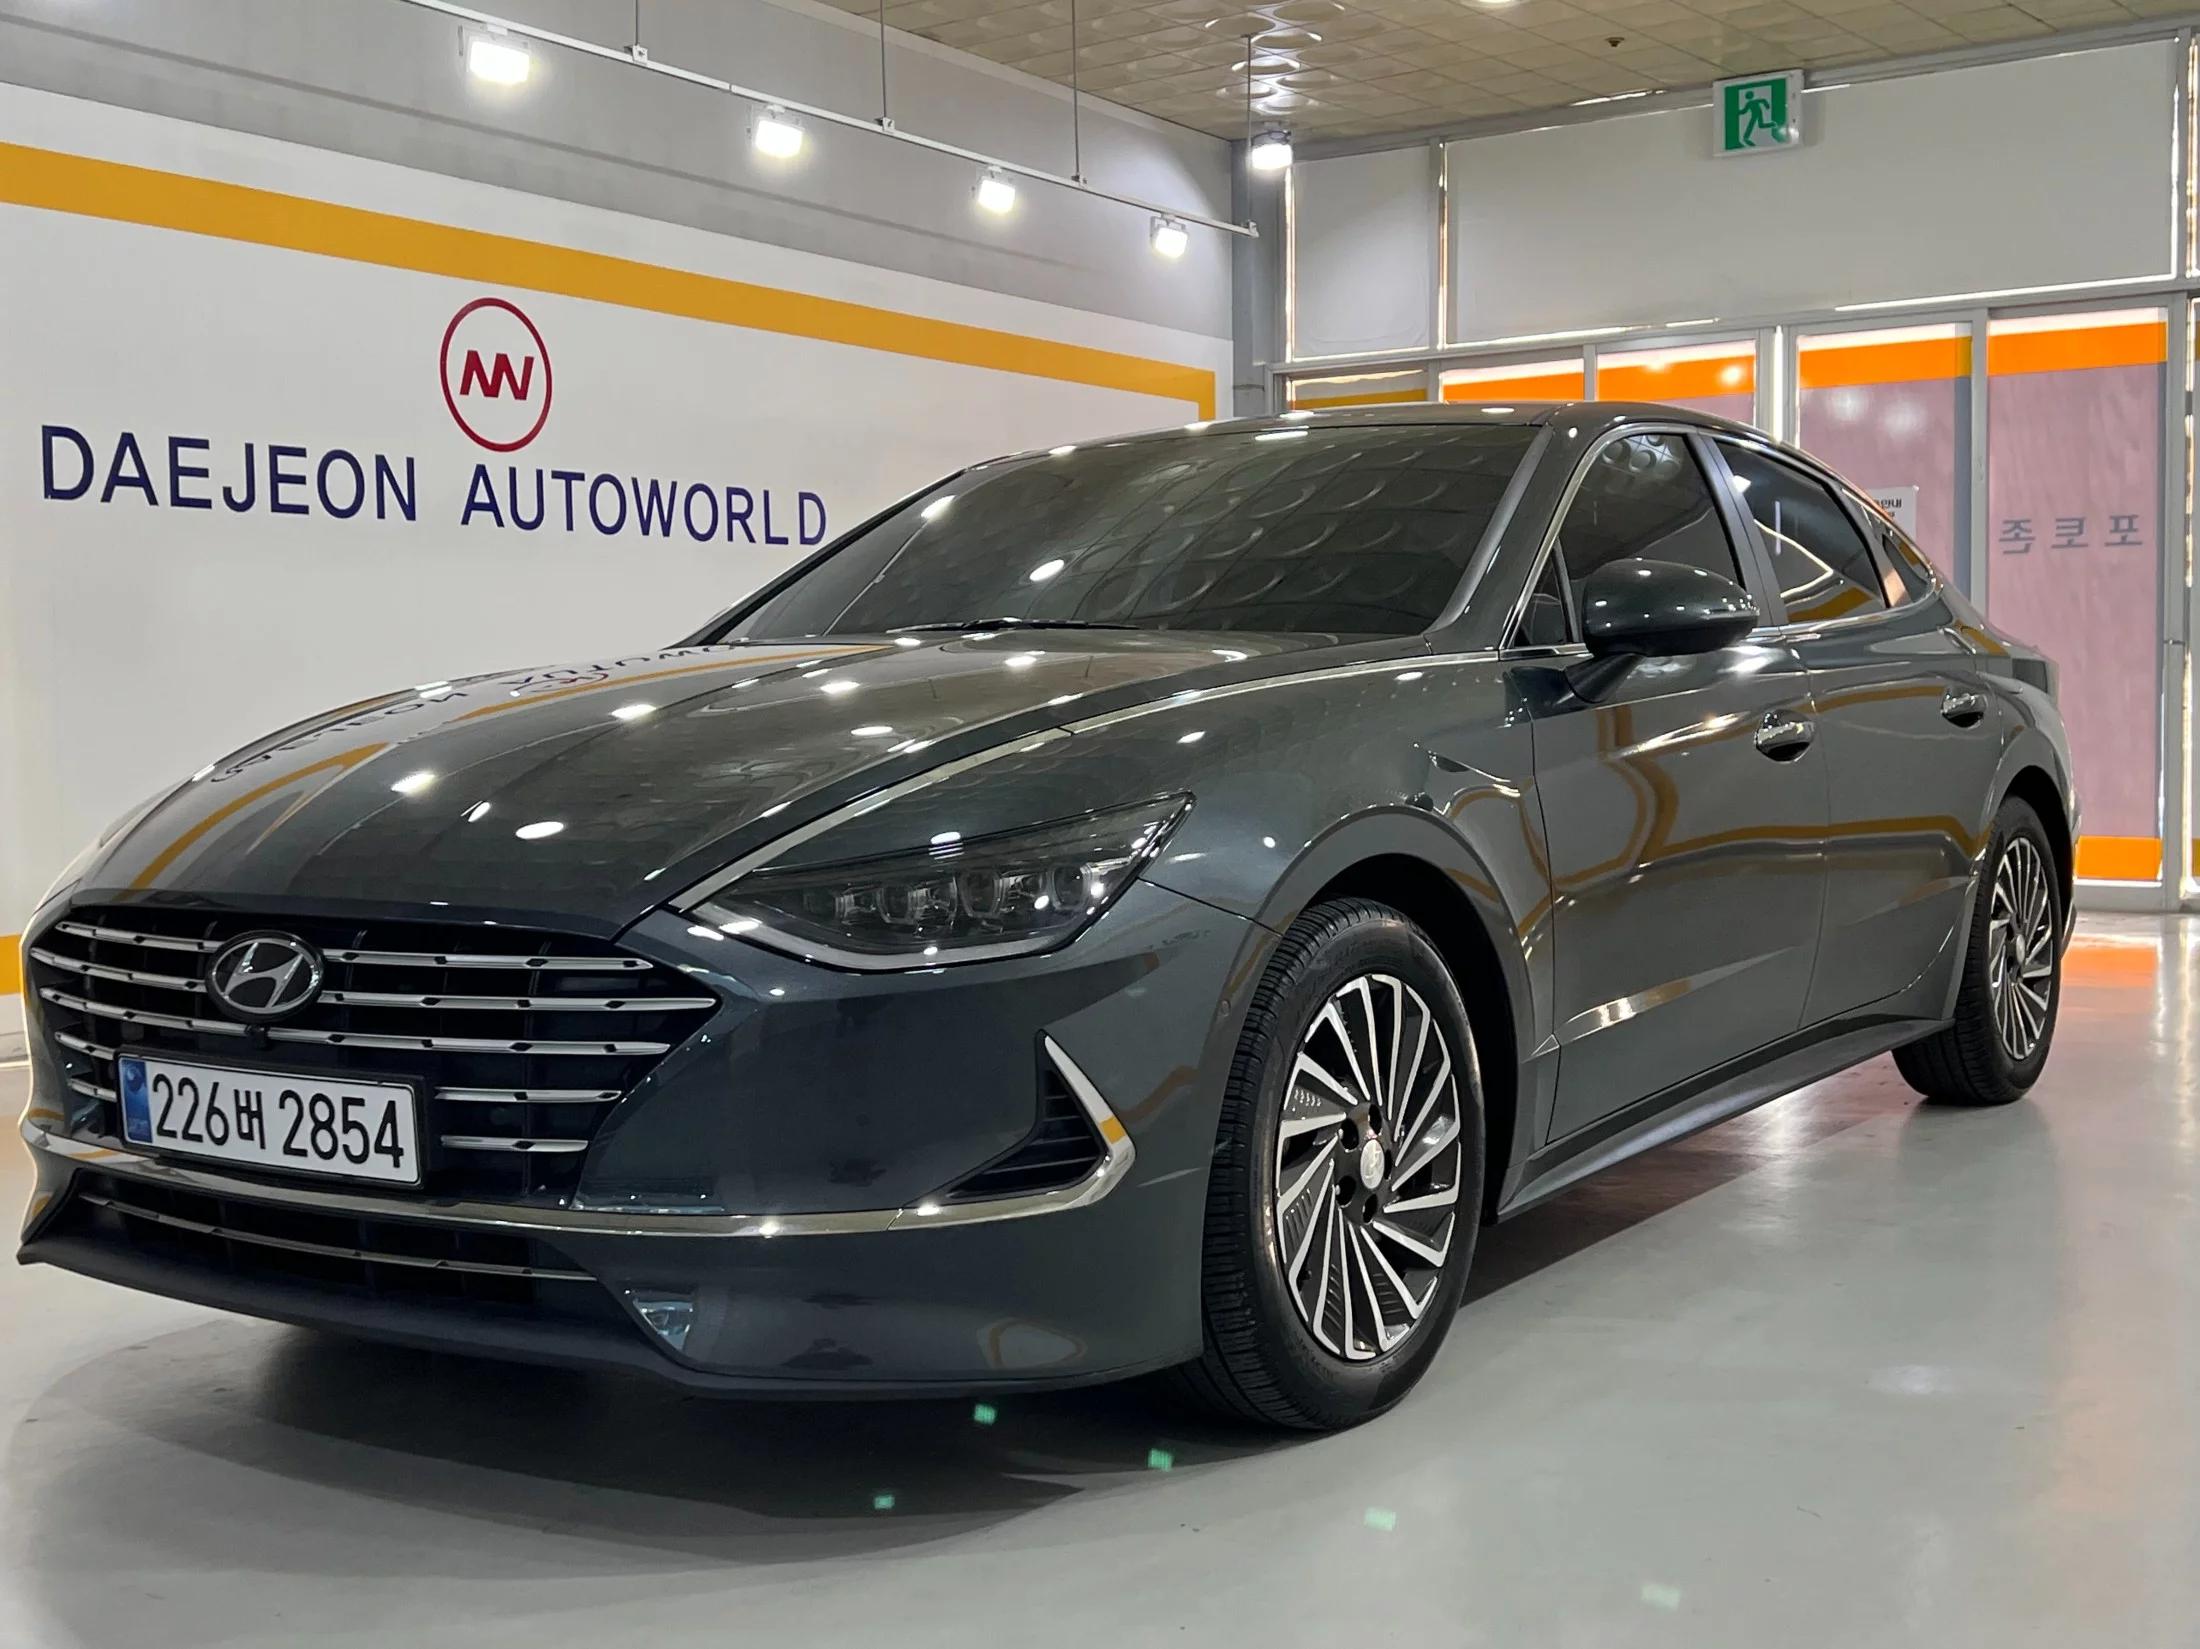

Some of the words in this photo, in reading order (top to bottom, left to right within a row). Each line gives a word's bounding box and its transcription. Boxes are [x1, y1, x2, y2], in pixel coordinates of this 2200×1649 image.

[41, 424, 417, 522] DAEJEON
[460, 463, 827, 546] AUTOWORLD
[152, 1073, 266, 1150] 226버
[278, 1089, 405, 1169] 2854
